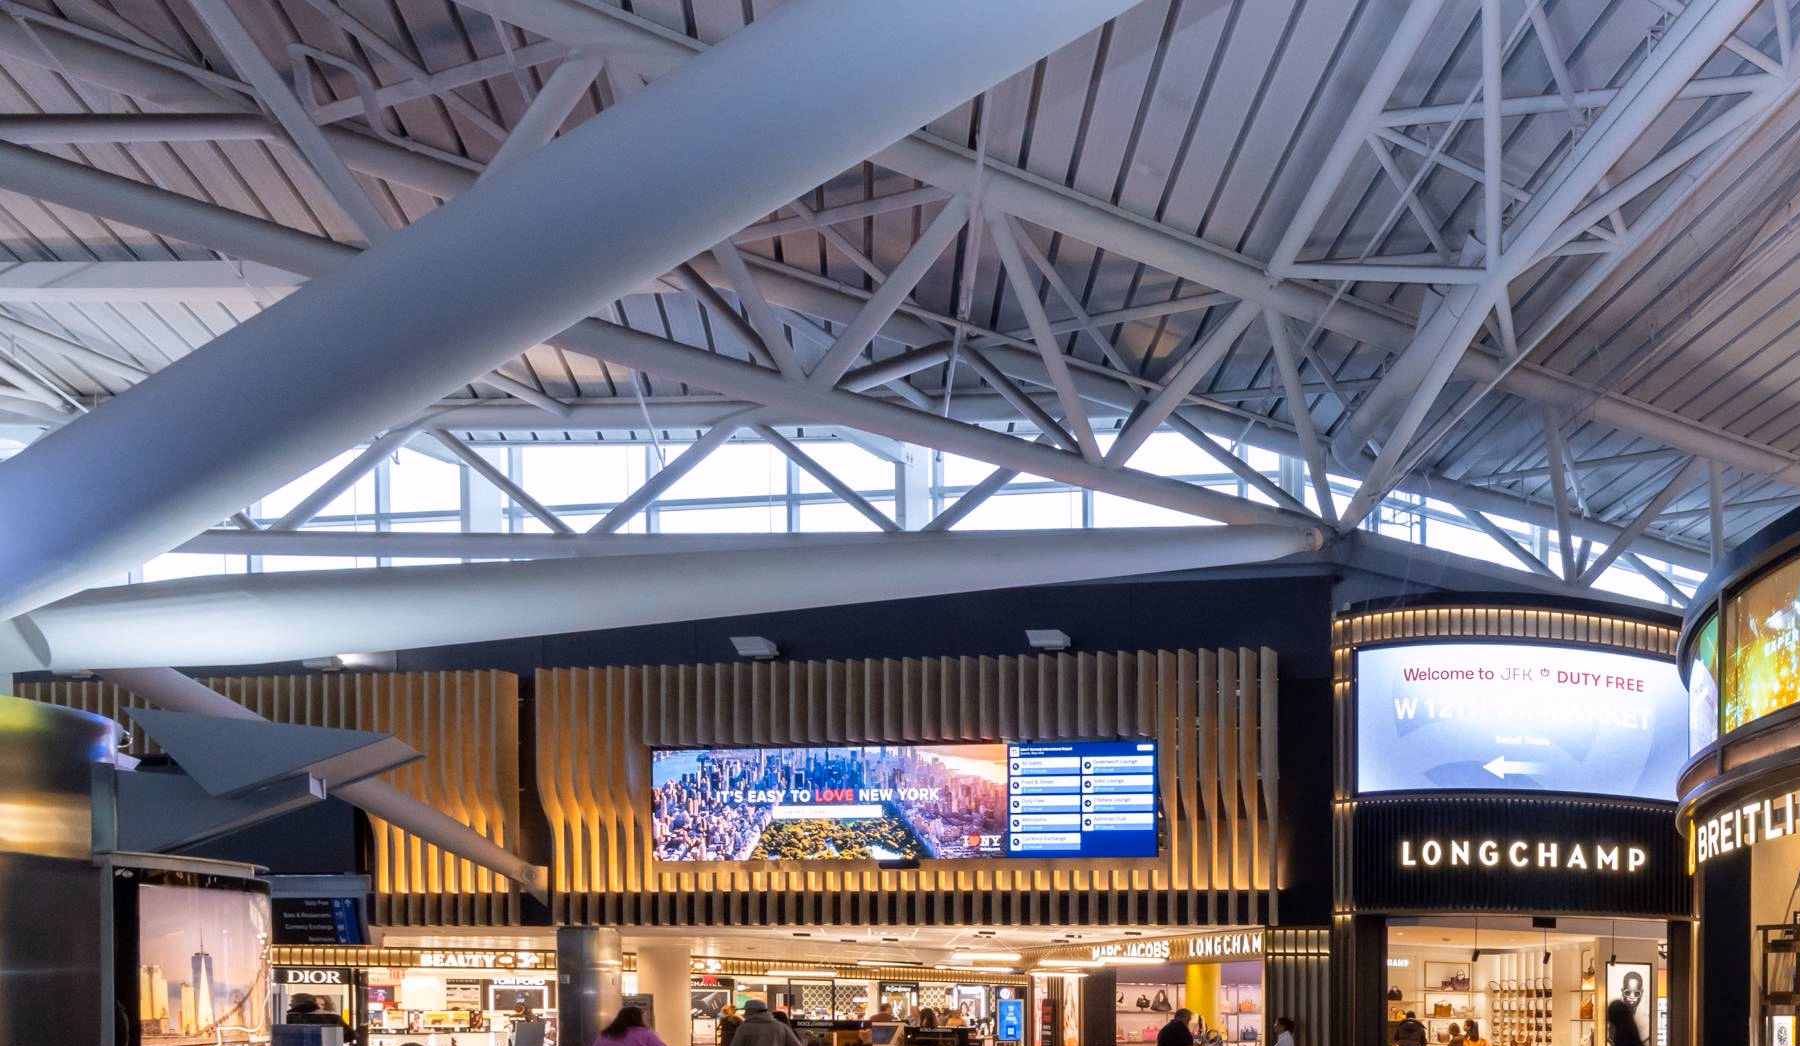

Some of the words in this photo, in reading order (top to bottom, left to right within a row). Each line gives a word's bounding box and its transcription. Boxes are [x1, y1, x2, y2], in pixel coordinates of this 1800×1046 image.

[1404, 668, 1474, 681] Welcome
[1478, 668, 1494, 681] to
[1501, 668, 1532, 681] JFK
[1558, 670, 1601, 687] DUTY
[1606, 675, 1645, 692] FREE
[1394, 697, 1418, 720] W
[716, 790, 744, 802] IT'S
[748, 790, 786, 802] EASY
[791, 790, 811, 802] TO
[815, 789, 854, 802] LOVE
[859, 788, 893, 801] NEW
[898, 788, 939, 801] YORK
[1402, 840, 1646, 871] LONGCHAMP
[1124, 940, 1170, 958] JACOBS
[421, 953, 495, 968] BEAUTY
[287, 970, 341, 984] DIOR
